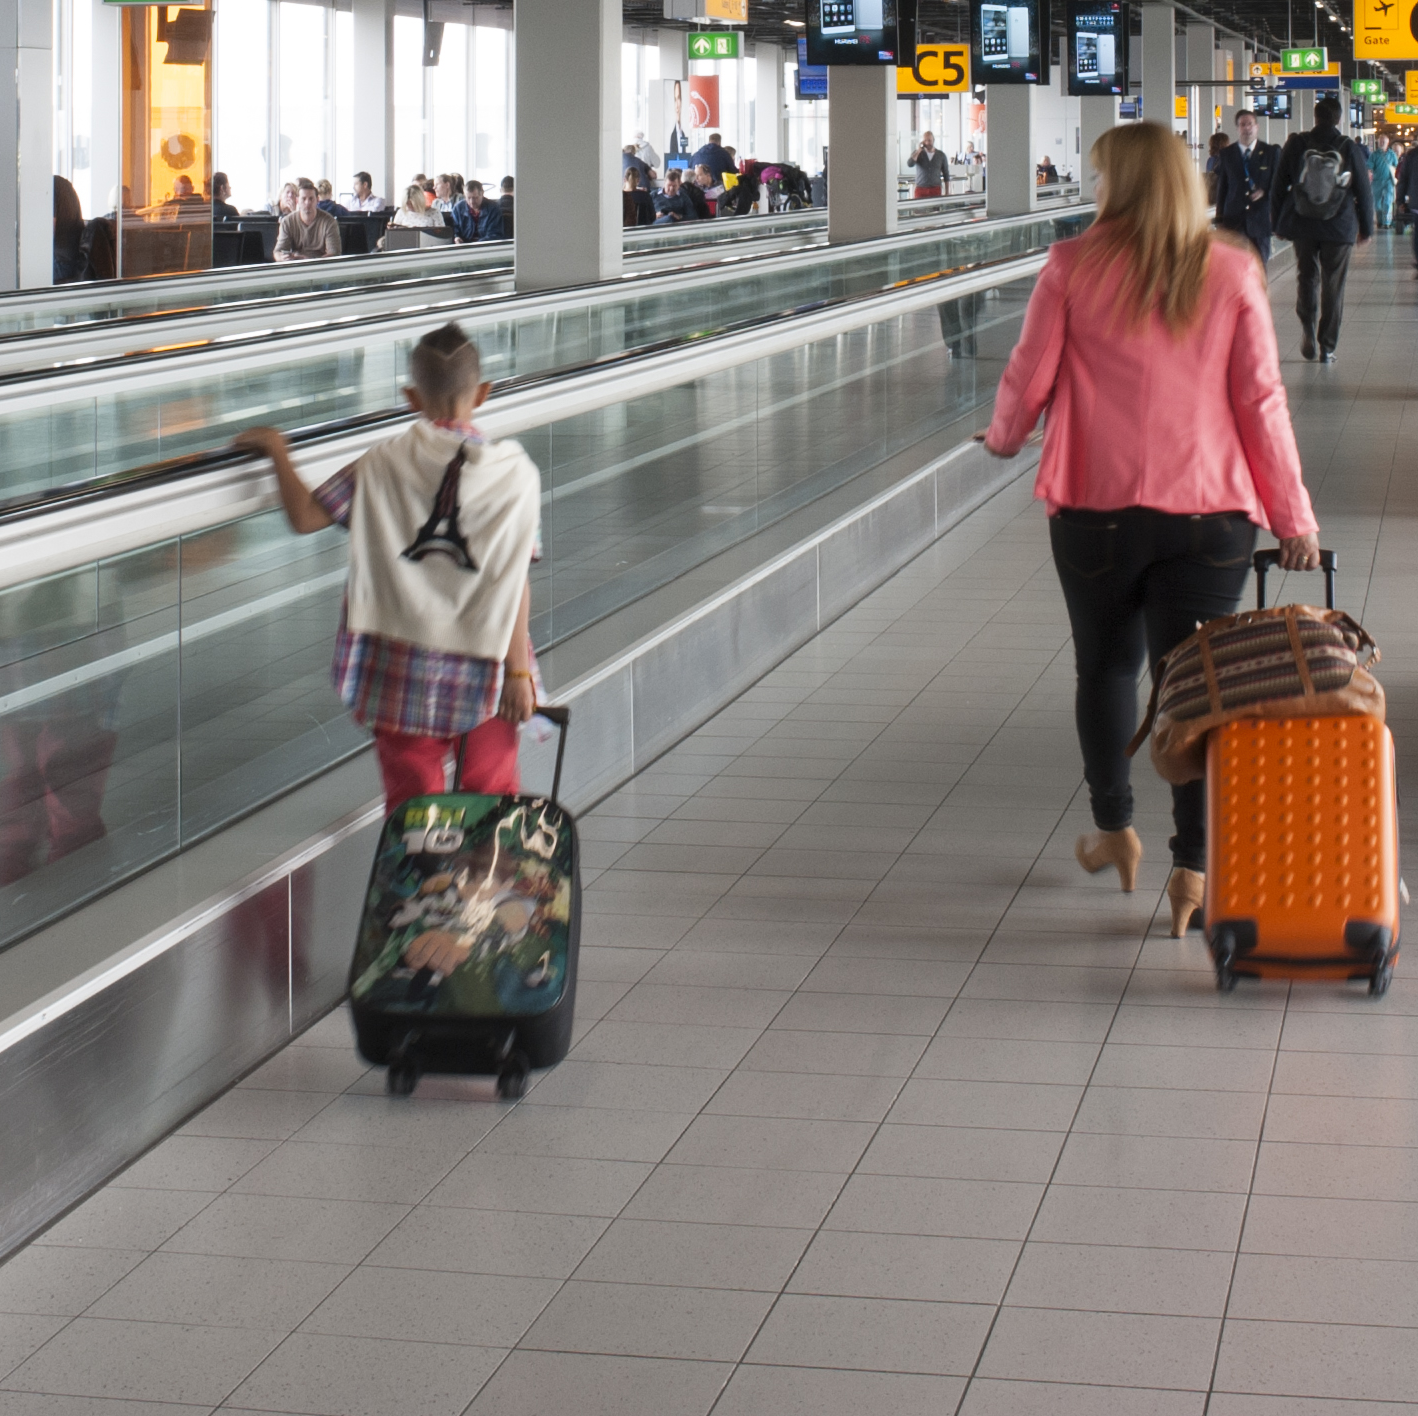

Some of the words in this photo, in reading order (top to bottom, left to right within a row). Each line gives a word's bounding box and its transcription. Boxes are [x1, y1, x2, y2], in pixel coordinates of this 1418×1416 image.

[1364, 35, 1390, 45] Gate
[911, 50, 965, 87] C5
[401, 828, 465, 855] 10
